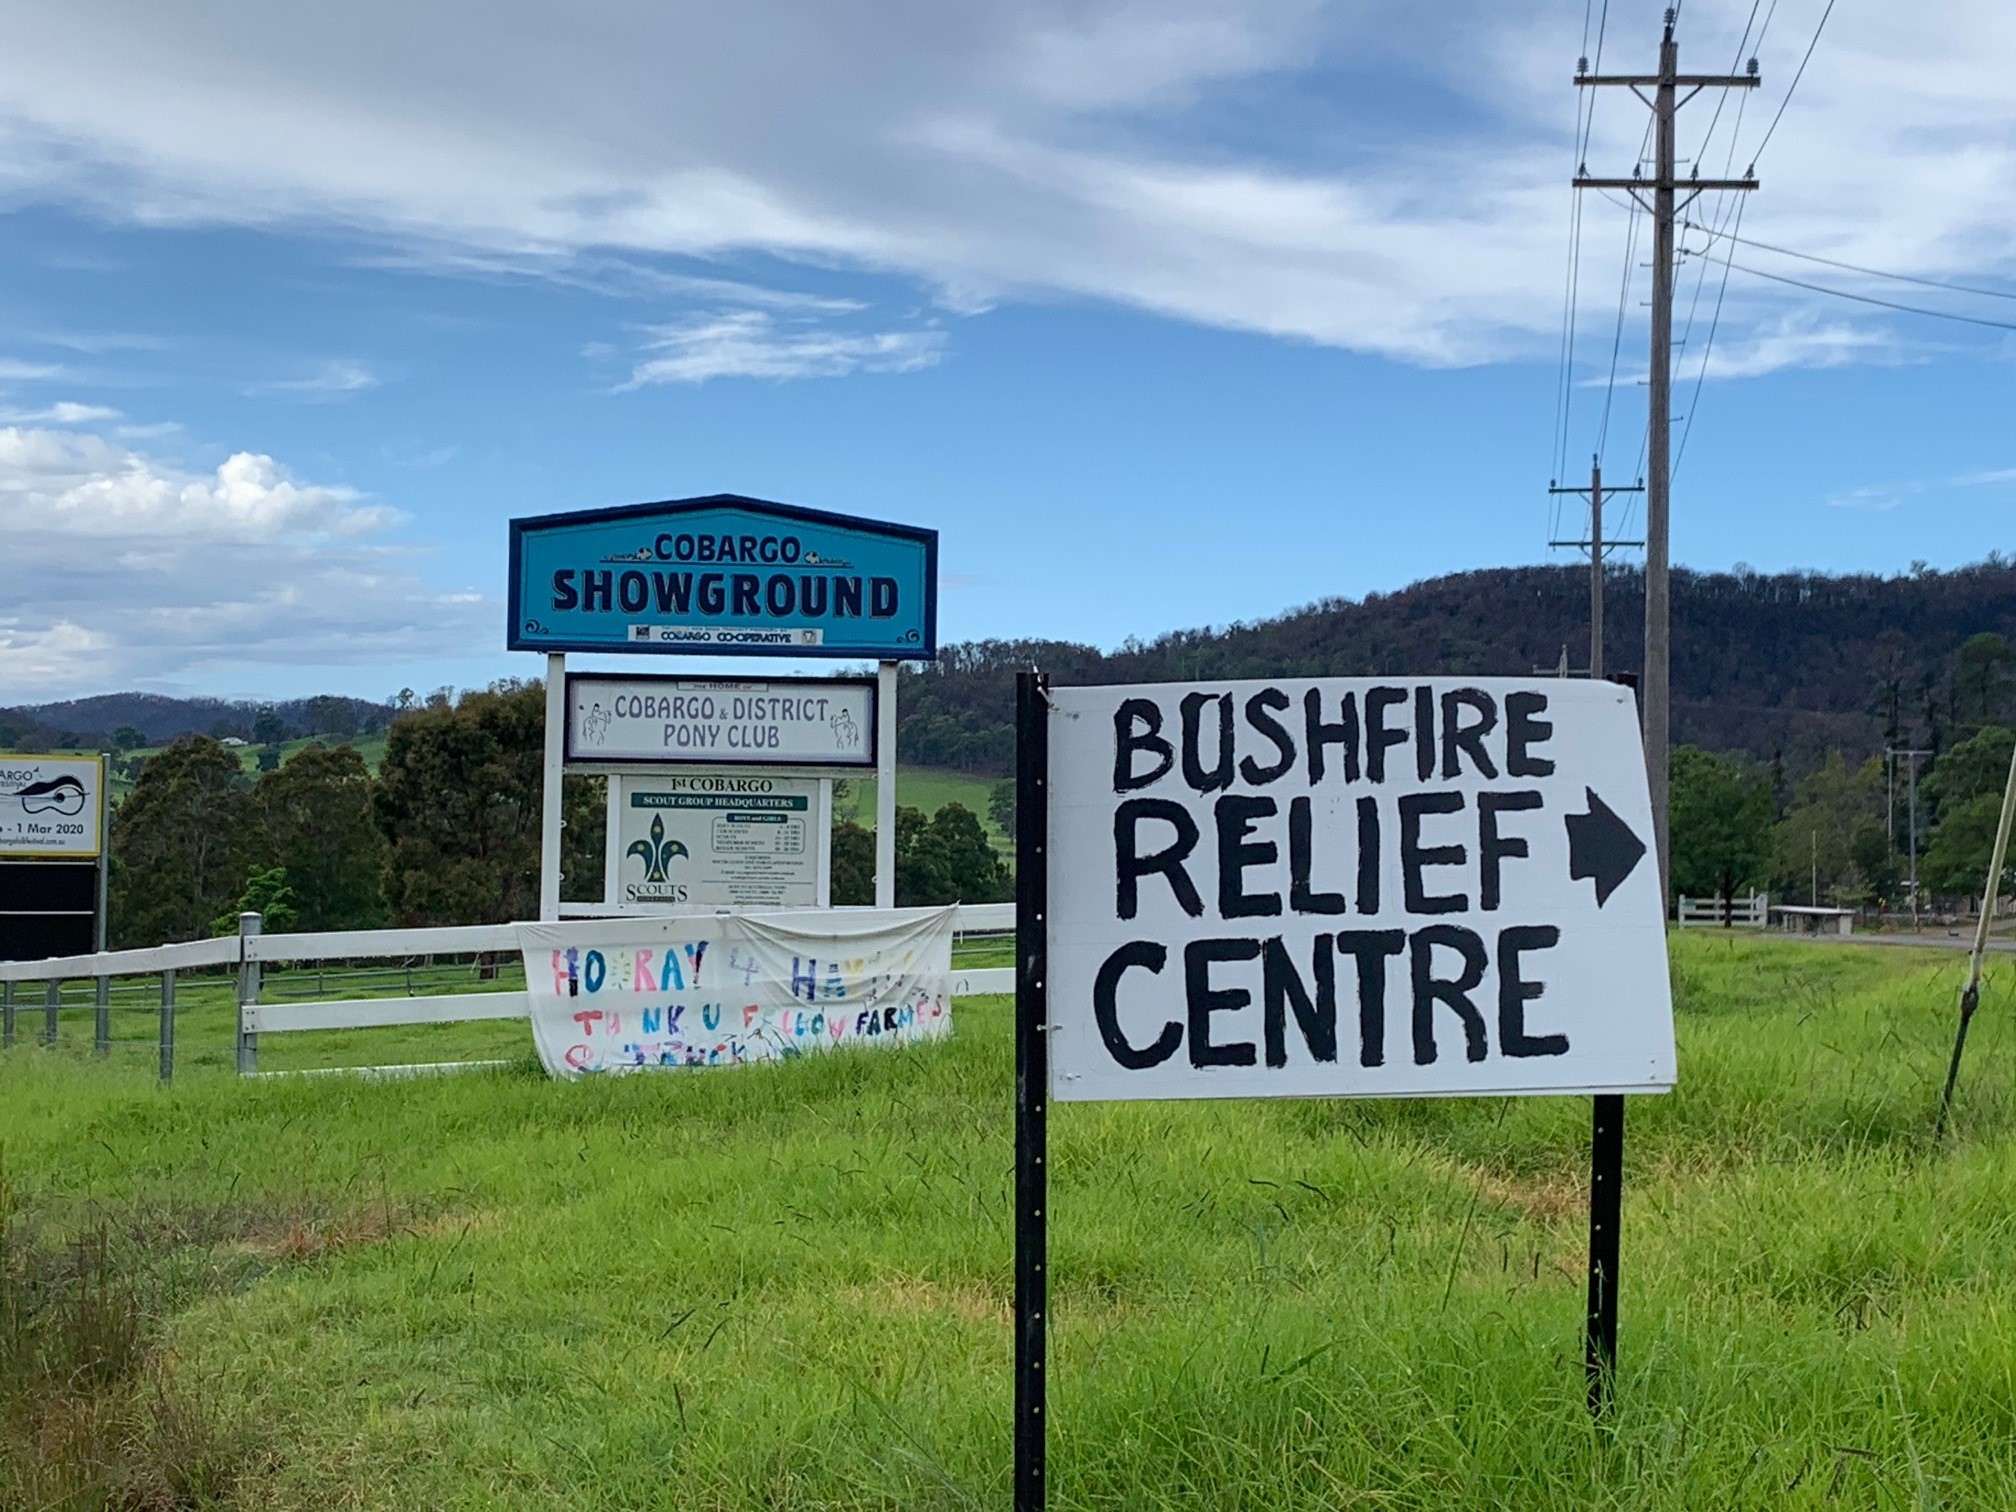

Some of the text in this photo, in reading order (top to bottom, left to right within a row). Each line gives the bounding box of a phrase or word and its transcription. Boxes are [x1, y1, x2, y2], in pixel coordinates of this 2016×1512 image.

[654, 533, 801, 563] COBARGO
[551, 569, 899, 619] SHOWGROUND
[615, 695, 829, 721] COBARGO & DISTRICT
[664, 724, 780, 748] PONY CLUB
[1113, 685, 1556, 796] BUSHFIRE
[671, 777, 773, 793] 1st COBARGO
[643, 795, 794, 809] SCOUT GROUP HEADQUARTERS
[17, 822, 22, 833] 1
[27, 823, 52, 833] Mar
[56, 824, 84, 834] 2020
[1113, 790, 1544, 920] RELIEF
[626, 883, 688, 903] SCOUTS
[1093, 924, 1570, 1071] CENTRE
[573, 1005, 685, 1036] THNK
[702, 1002, 721, 1031] U
[743, 1004, 847, 1040] FLLOW
